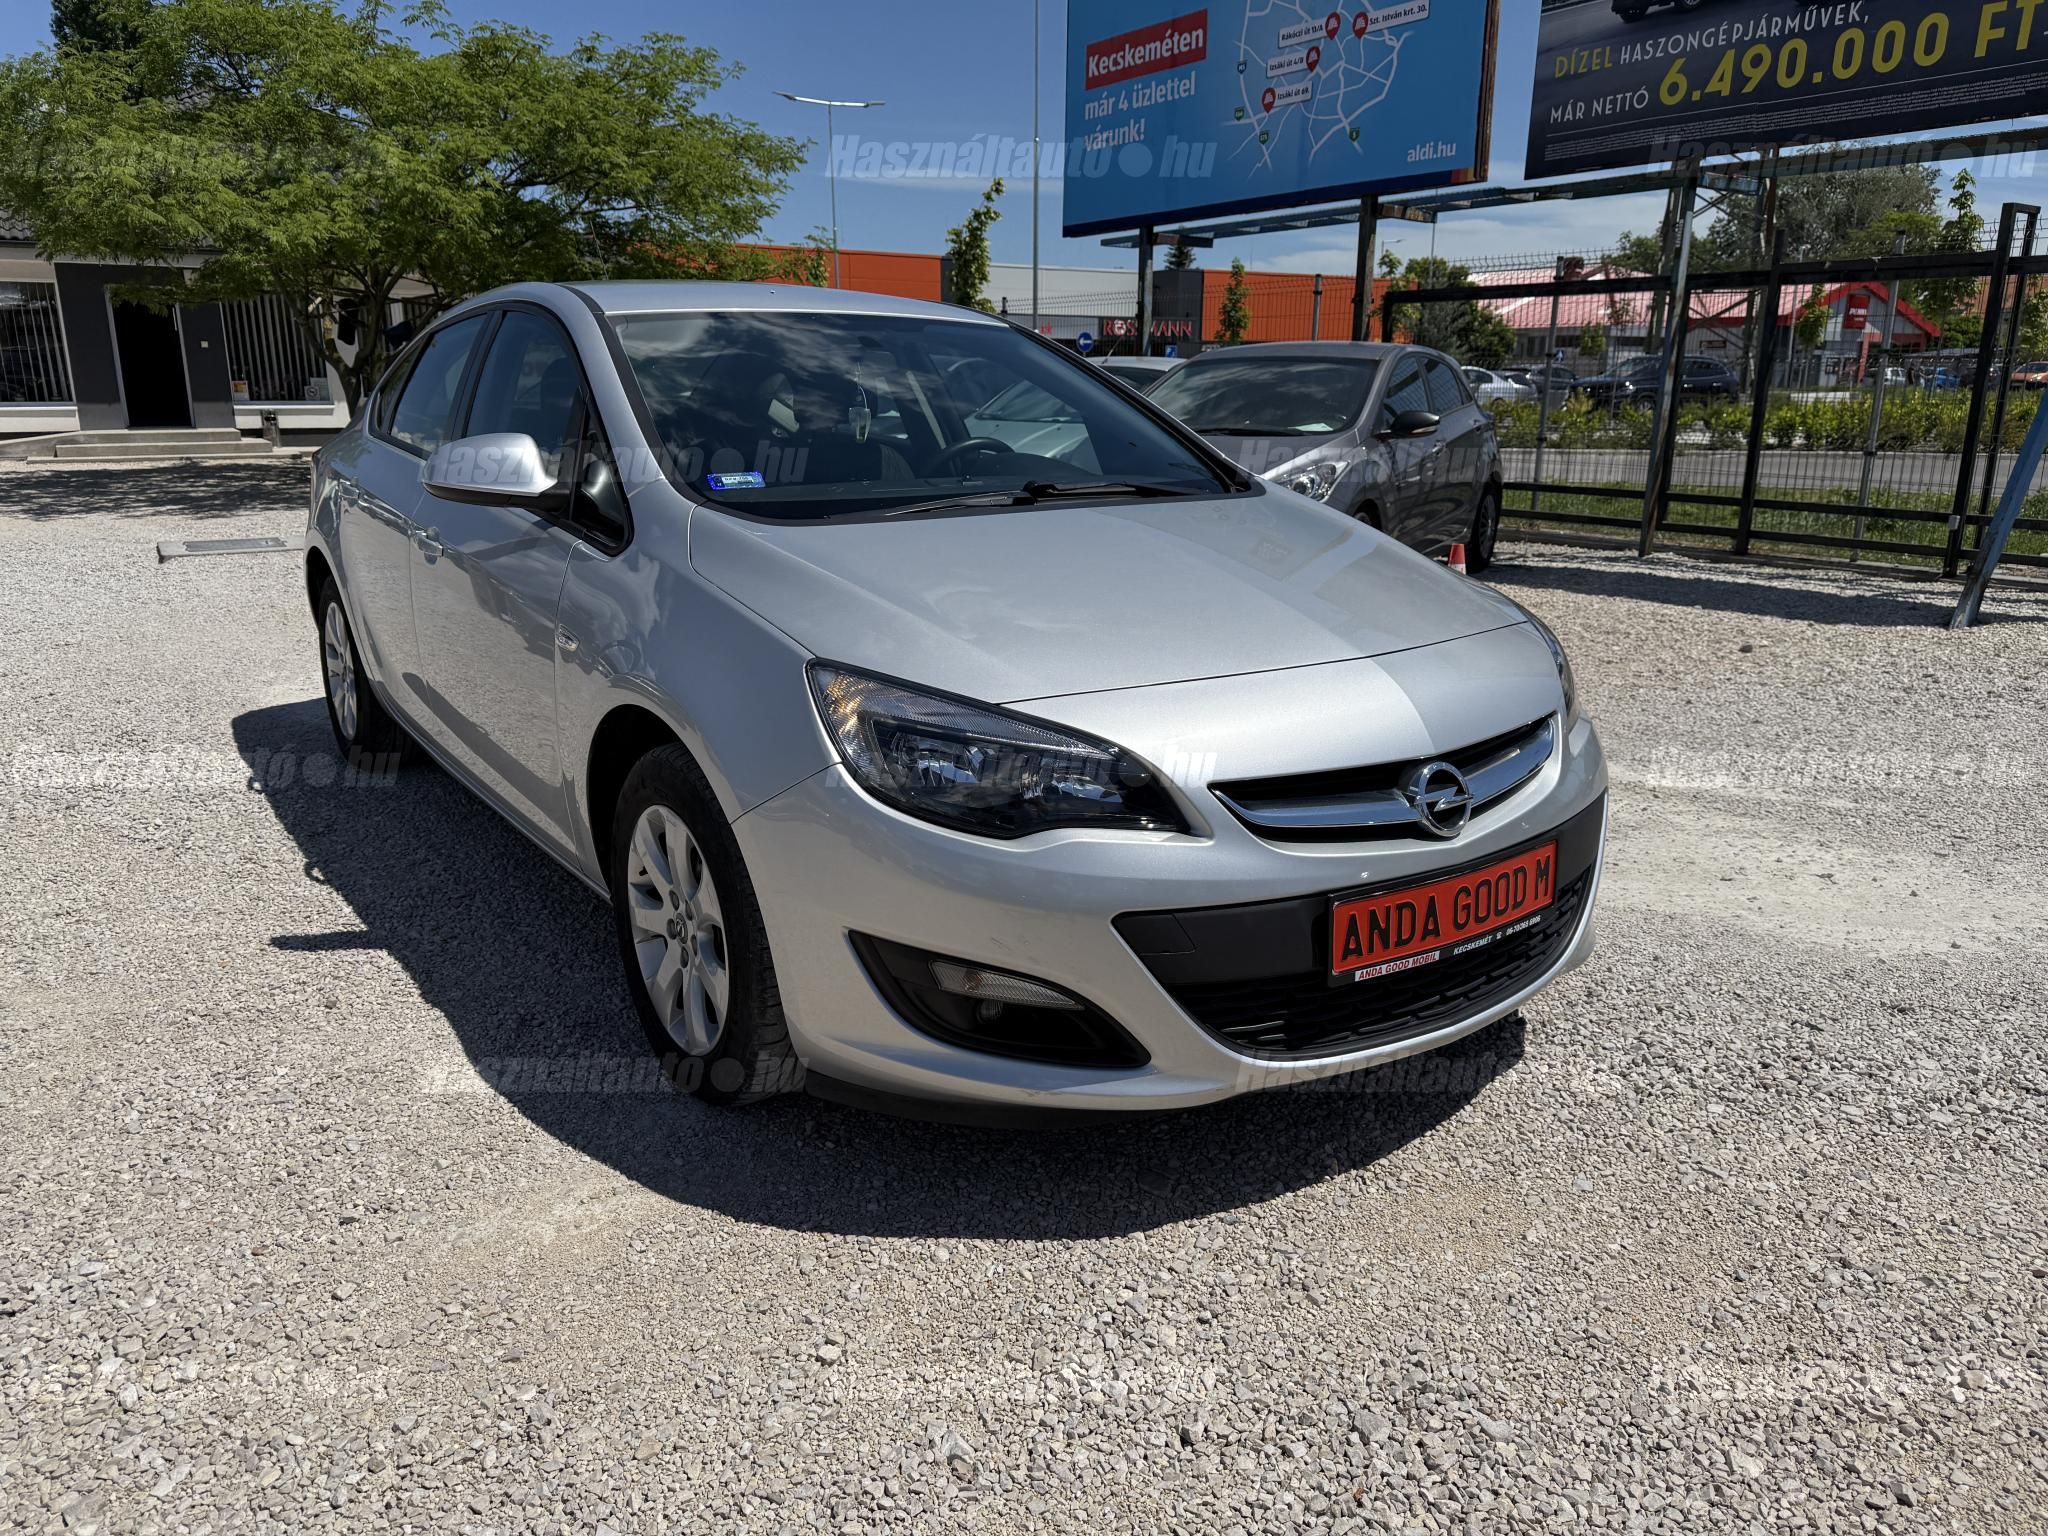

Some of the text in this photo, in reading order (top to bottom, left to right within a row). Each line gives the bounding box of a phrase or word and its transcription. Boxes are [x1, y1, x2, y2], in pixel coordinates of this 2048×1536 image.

[1403, 7, 1416, 17] krt.
[1087, 28, 1204, 78] Kecskeméten
[1555, 1, 1869, 79] DÍZEL HASZONGÉPJÁRMŰVEK,
[1658, 0, 2045, 106] 6.490.000 FT
[1084, 71, 1196, 120] már 4 üzlettel
[1550, 86, 1649, 124] MÁR NETTÓ
[1084, 118, 1146, 152] várunk!
[1407, 140, 1457, 163] aldi.hu
[1341, 854, 1552, 961] ANDA GOOD M
[1453, 935, 1493, 956] KECSKEMÉT
[1358, 952, 1437, 980] ANDA GOOD MOBIL
